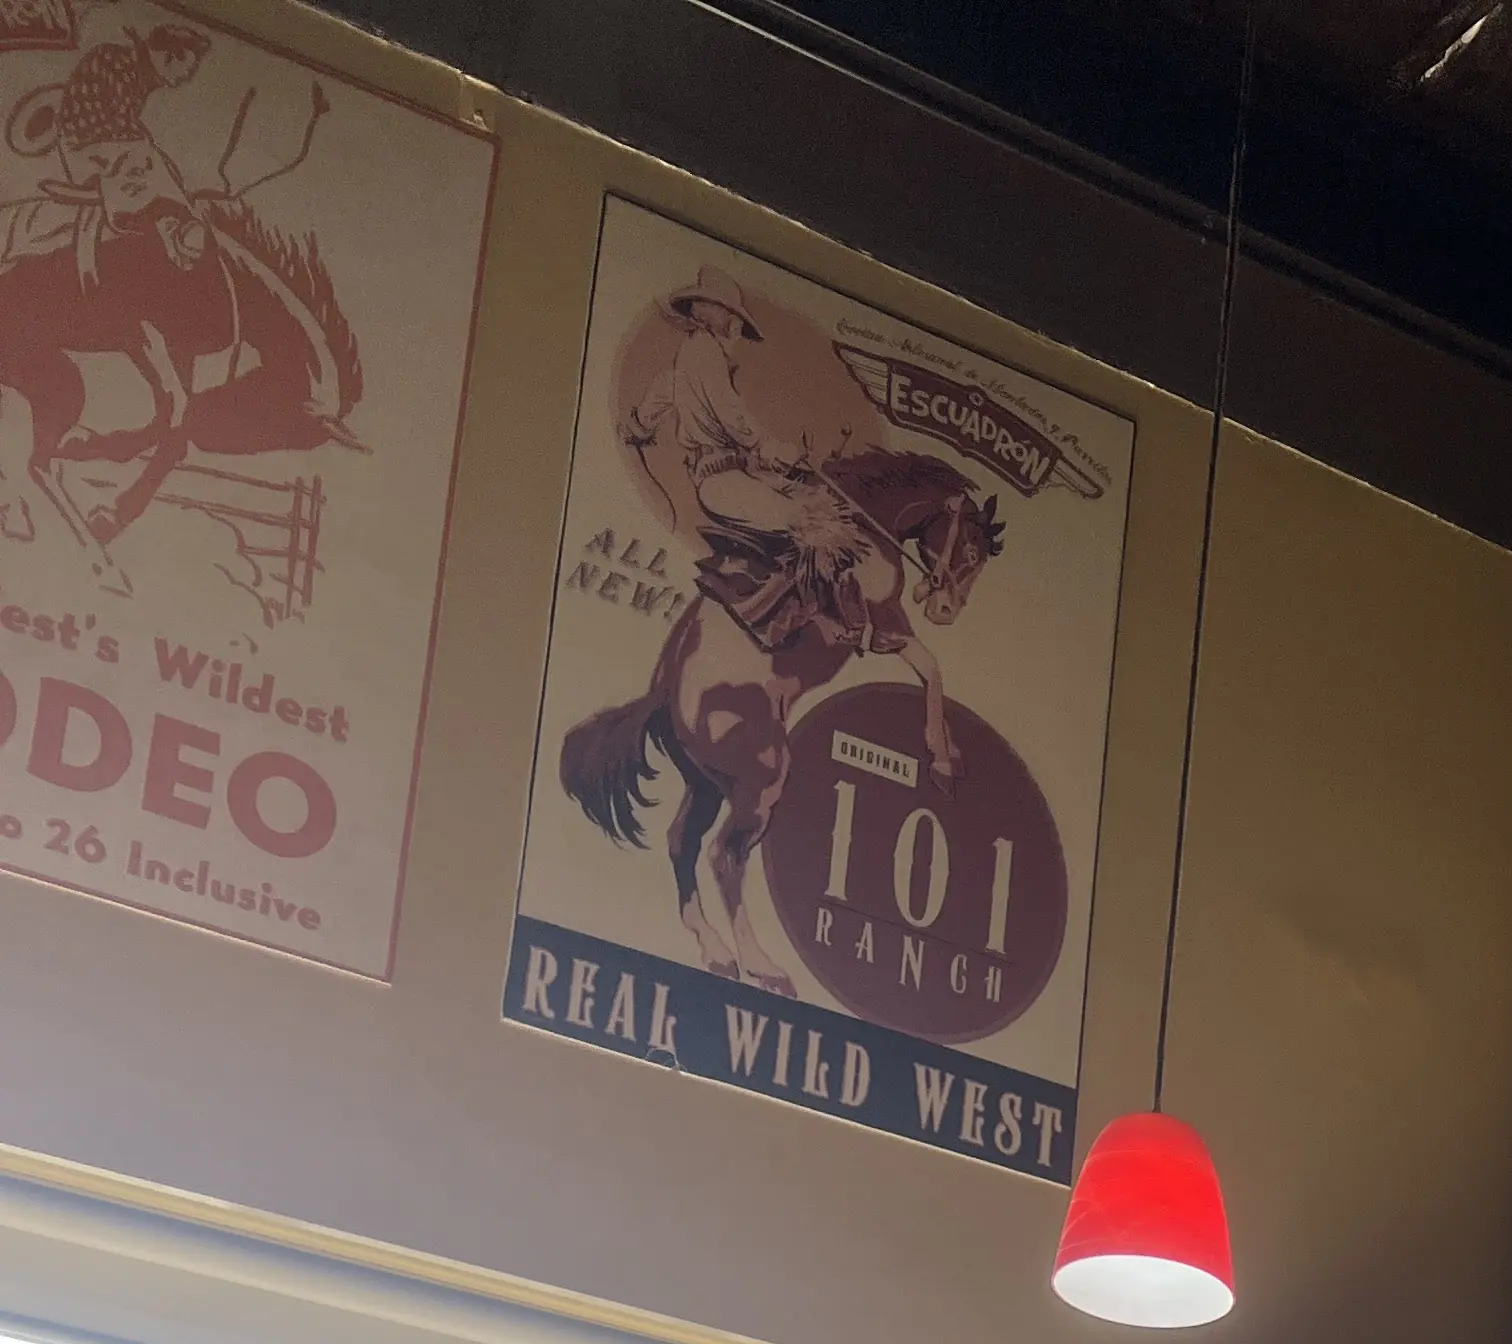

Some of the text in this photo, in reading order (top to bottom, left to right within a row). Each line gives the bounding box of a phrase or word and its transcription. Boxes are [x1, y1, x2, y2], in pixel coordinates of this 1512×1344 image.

[889, 369, 1050, 486] ESCUADRÓN
[564, 560, 686, 621] NEW!
[585, 527, 668, 579] ALL
[154, 636, 350, 743] Wildest
[0, 671, 338, 859] DEO
[840, 740, 910, 778] ORIGINAL
[43, 815, 107, 864] 26
[126, 839, 322, 931] Inclusive
[823, 778, 1016, 954] 101
[814, 906, 1003, 1003] RANCH
[521, 944, 1063, 1169] REAL WILD WEST
